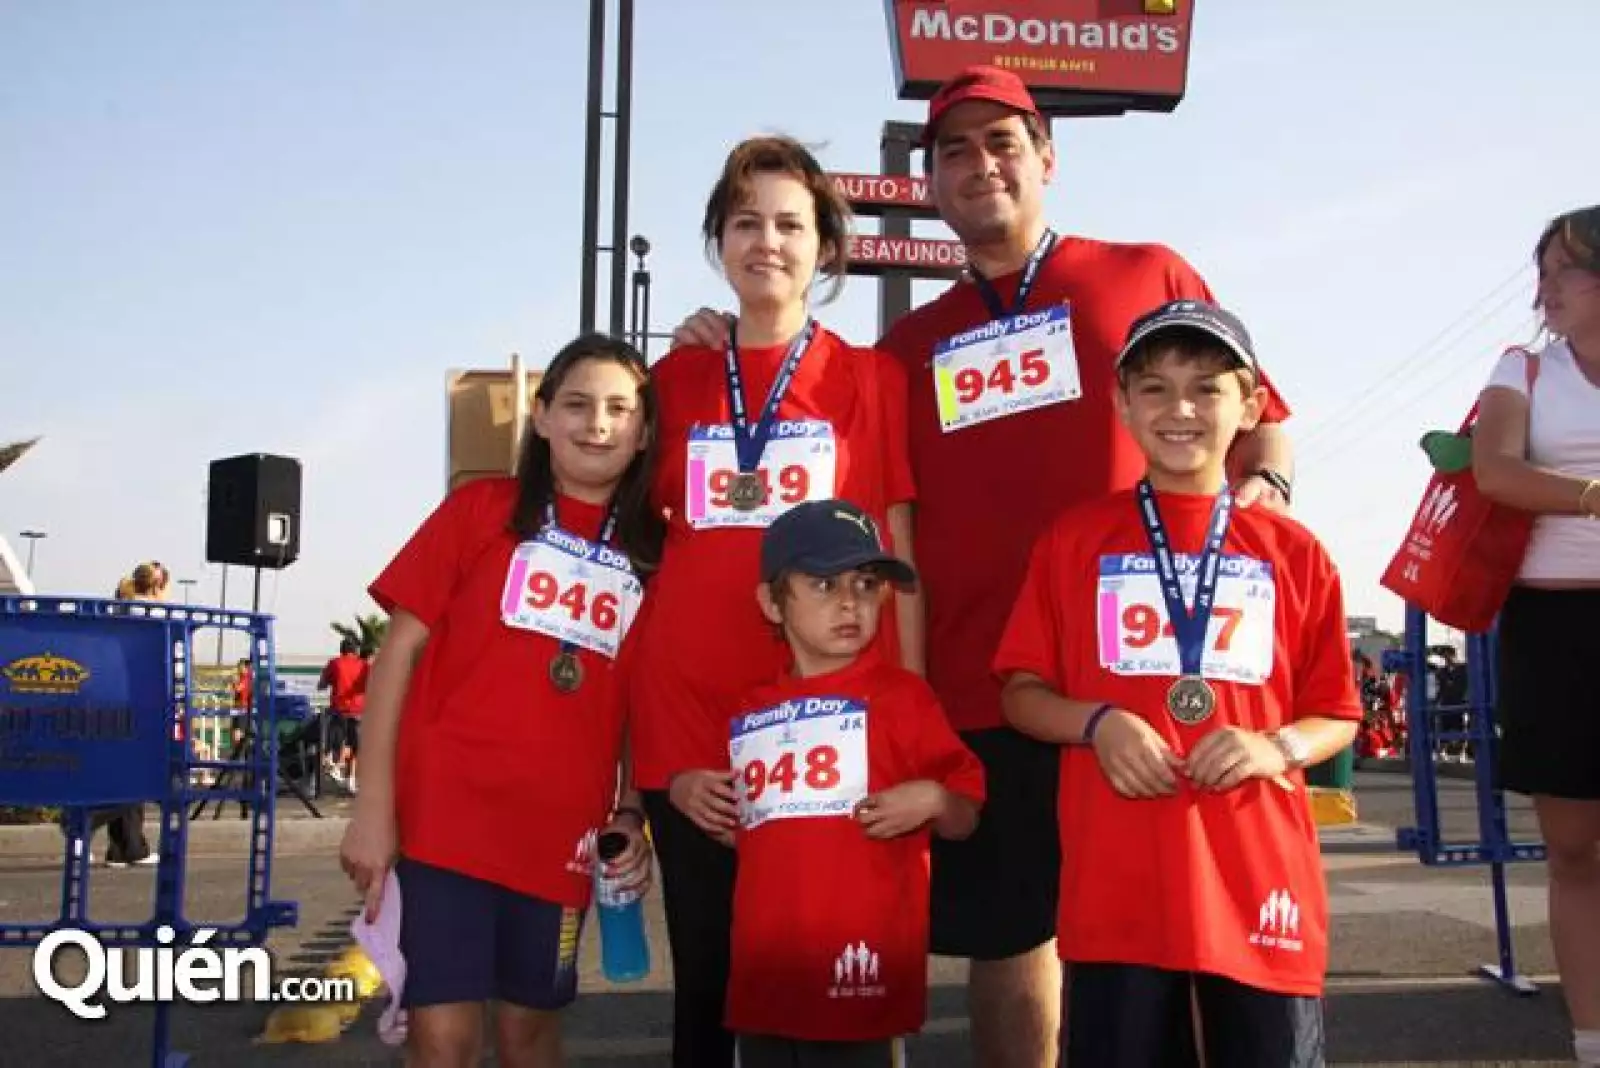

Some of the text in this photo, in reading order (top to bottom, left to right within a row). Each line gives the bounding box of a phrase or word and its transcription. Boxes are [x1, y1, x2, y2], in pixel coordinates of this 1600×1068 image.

[910, 9, 1179, 52] McDonald's
[993, 54, 1096, 73] RESTAURANTE
[833, 176, 928, 201] AUTO-M
[847, 238, 966, 265] ESAYUNOS
[953, 349, 1050, 404] 945
[526, 571, 620, 630] 946
[1122, 604, 1243, 651] 97
[804, 697, 850, 715] Day
[744, 745, 841, 802] 948
